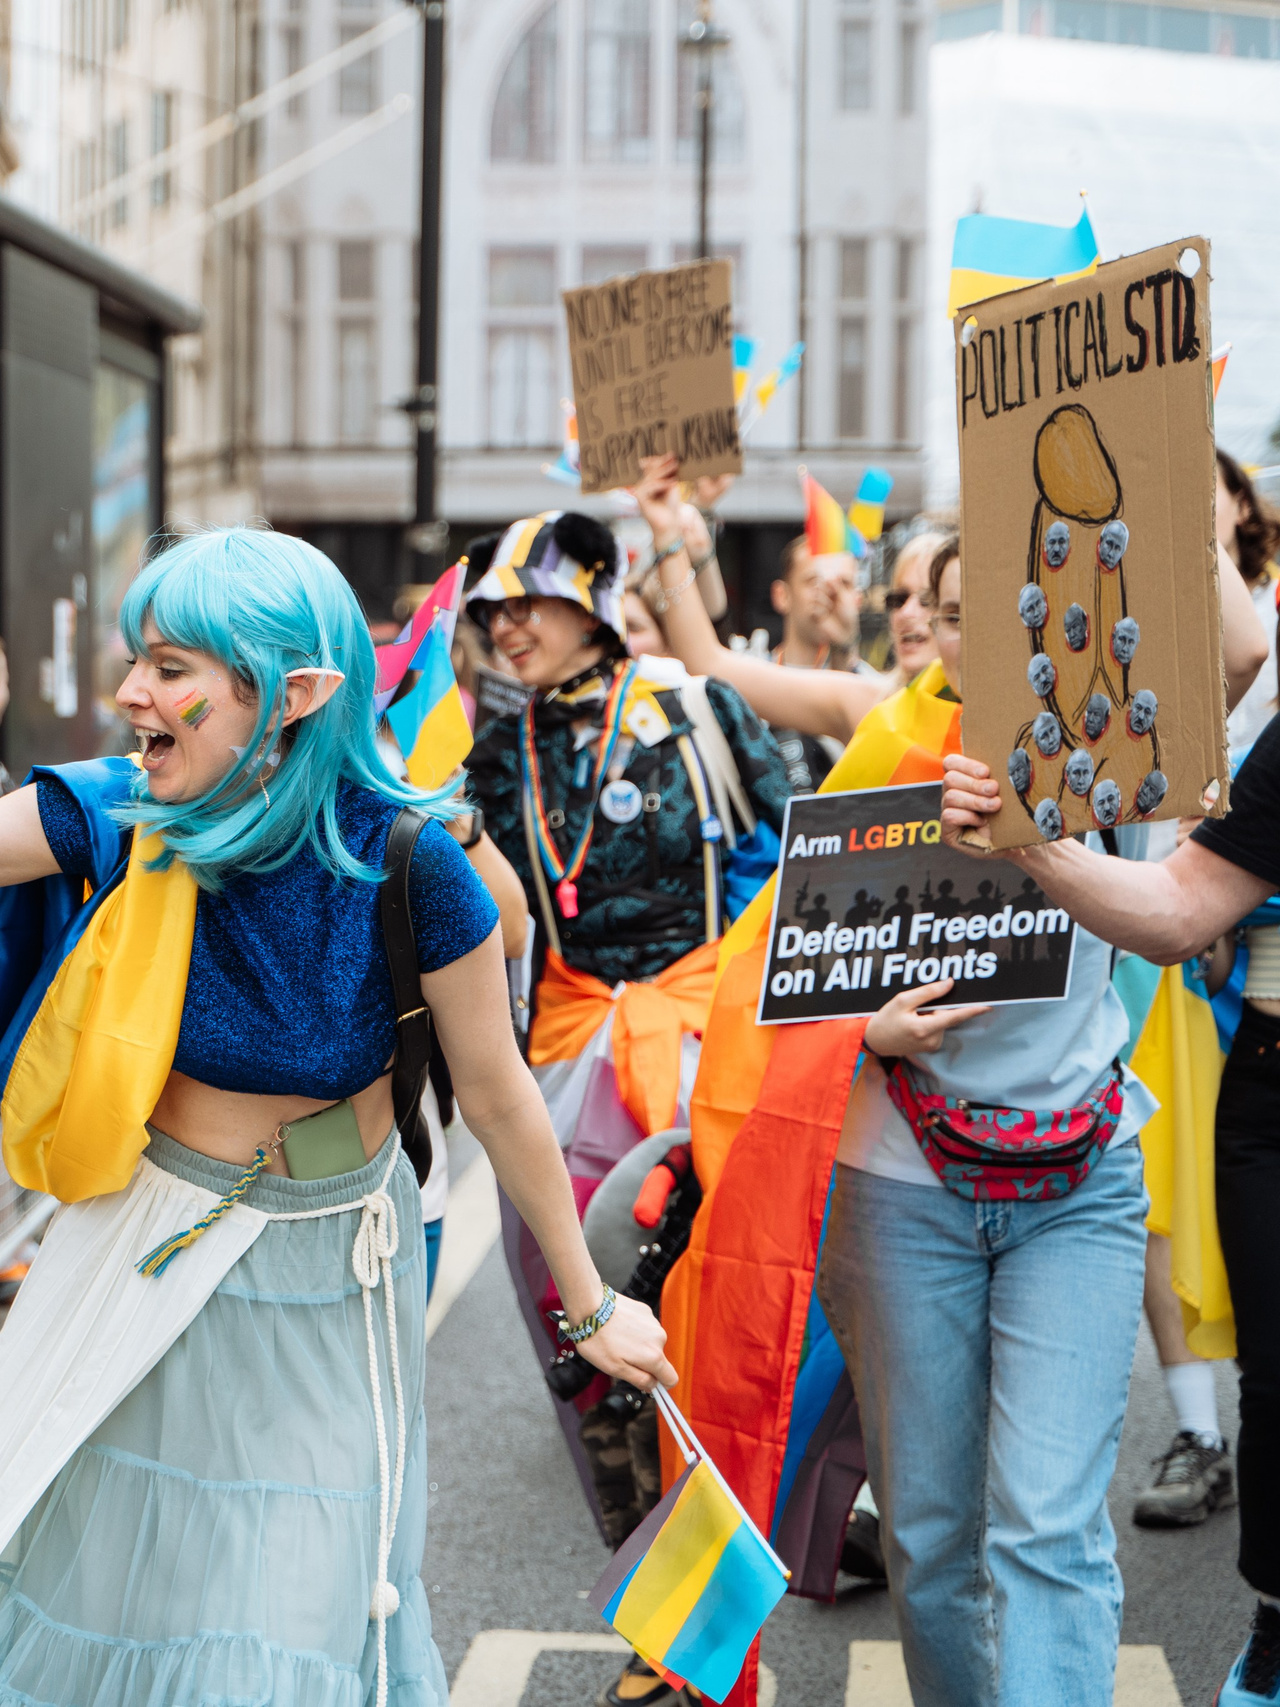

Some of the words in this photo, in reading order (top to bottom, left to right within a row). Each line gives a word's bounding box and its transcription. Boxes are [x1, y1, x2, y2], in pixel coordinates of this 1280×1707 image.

[566, 289, 600, 346] NO
[597, 278, 645, 337] ONE
[570, 334, 643, 397] UNTIL
[961, 291, 1122, 428] POLITICAL
[579, 396, 604, 444] IS
[787, 833, 842, 860] Arm
[847, 818, 942, 853] LGBTQ
[776, 914, 901, 959] Defend
[908, 904, 1070, 946] Freedom
[770, 967, 815, 997] on
[822, 956, 873, 992] All
[880, 948, 998, 987] Fronts
[598, 1300, 615, 1325] PRIDE
